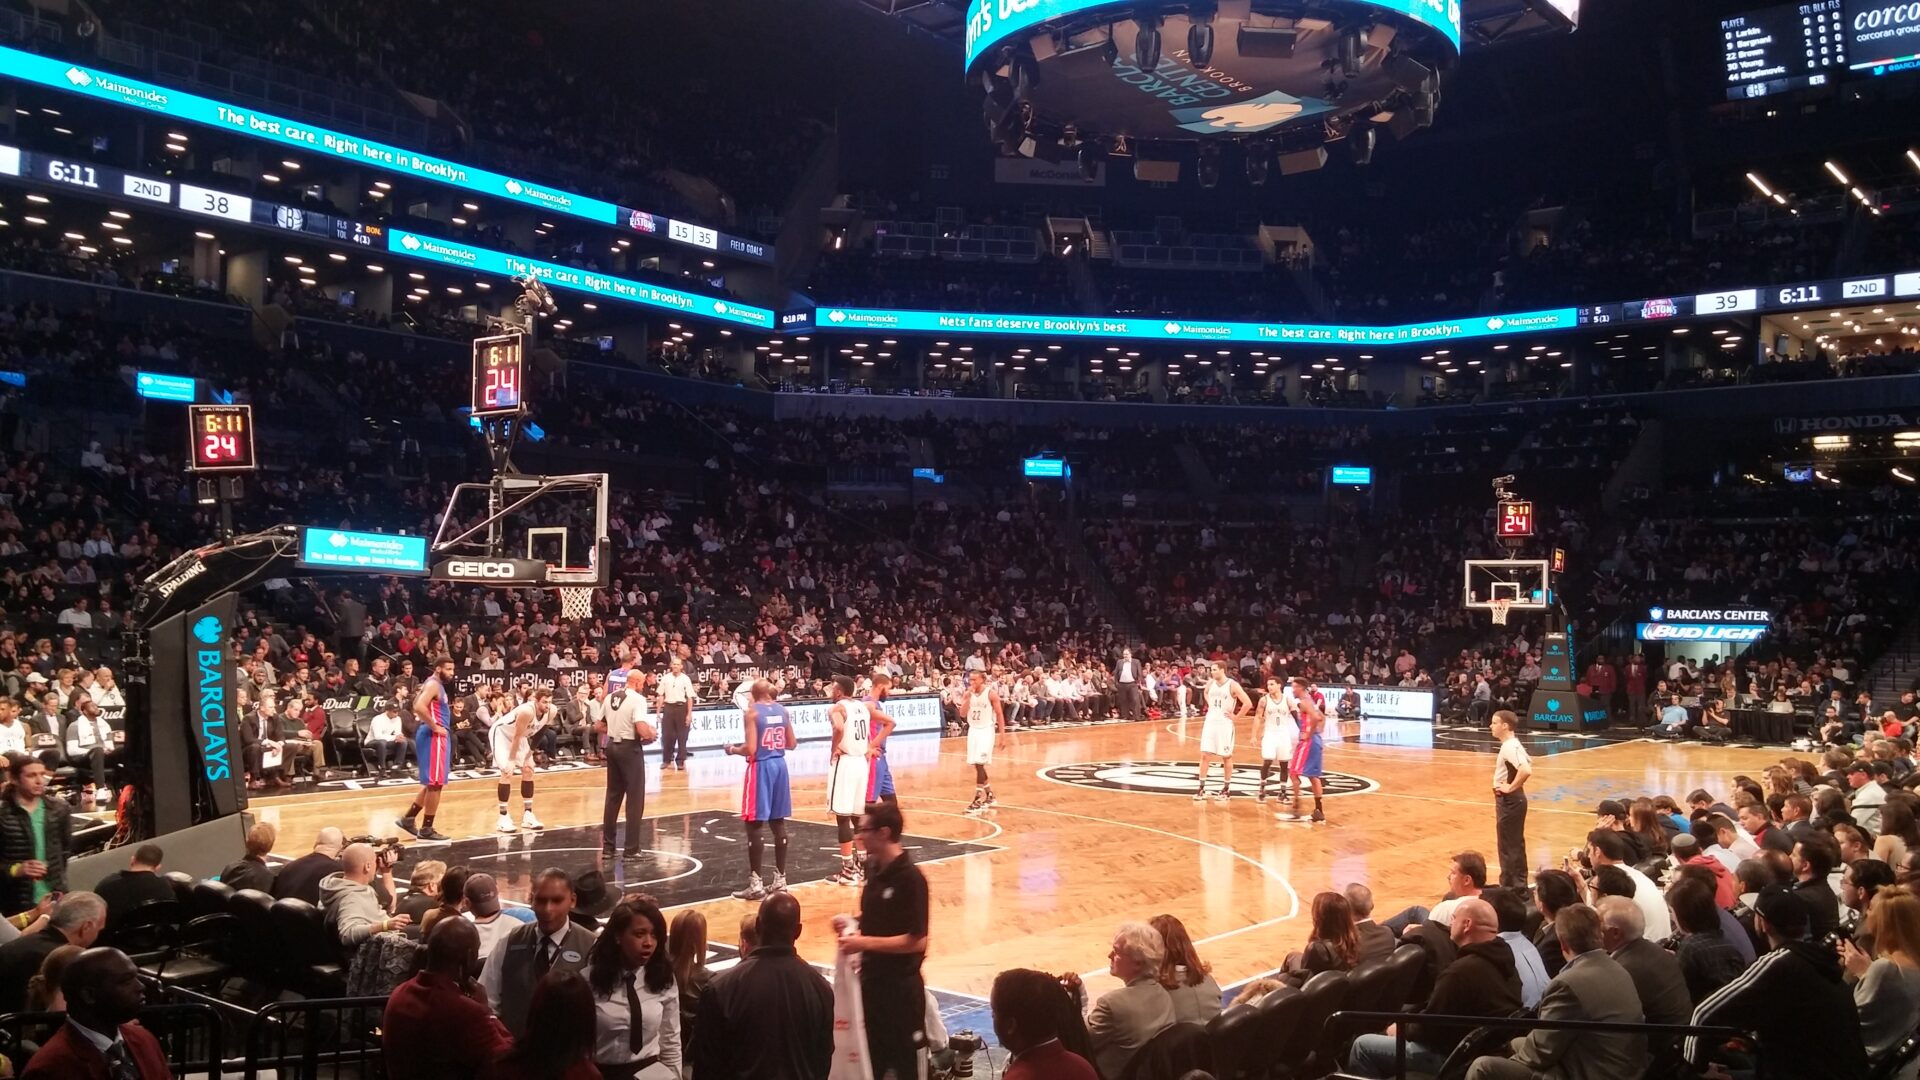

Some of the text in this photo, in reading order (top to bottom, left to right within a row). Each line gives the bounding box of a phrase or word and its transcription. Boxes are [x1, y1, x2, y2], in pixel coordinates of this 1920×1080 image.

[1799, 5, 1811, 16] STL
[1721, 17, 1745, 30] PLAYER
[1725, 12, 1840, 40] 0 Larkin 0 0 0
[1737, 35, 1772, 48] Bargnani
[1804, 28, 1811, 36] 0
[1819, 25, 1826, 33] 0
[1834, 23, 1841, 31] 0
[1856, 29, 1895, 42] corcoran
[1726, 33, 1842, 61] 22 Brown 1 0 0
[1727, 44, 1843, 71] 30 Young 0 0 2
[1728, 55, 1844, 81] 44 Bogdanovic 0 0 0
[95, 76, 168, 104] Maimonides
[217, 106, 470, 182] The best care. Right here in Brooklyn.
[49, 160, 98, 189] 6:11
[133, 181, 163, 198] 2ND
[203, 194, 230, 215] 38
[524, 186, 572, 207] Maimonides
[355, 222, 363, 233] 2
[675, 225, 712, 245] 15 35
[423, 241, 476, 264] Maimonides
[730, 239, 763, 257] FIELD GOALS
[505, 258, 695, 308] The best care. Right here in Brooklyn.
[1715, 282, 1877, 310] 39 6:11 2ND
[728, 306, 765, 323] Maimonides
[797, 313, 807, 322] PM
[848, 313, 898, 323] Maimonides
[1506, 315, 1559, 326] Maimonides
[1641, 305, 1679, 319] PISTONS
[939, 316, 1129, 333] Nets fans deserve Brooklyn's best.
[1183, 325, 1231, 334] Maimonides
[1258, 324, 1464, 342] The best care. Right here in Brooklyn.
[490, 345, 519, 367] 6:11
[486, 368, 515, 405] 24
[206, 415, 243, 433] 6:11
[1800, 412, 1909, 431] HONDA
[205, 434, 236, 459] 24
[1507, 505, 1529, 516] 6:11
[1504, 515, 1527, 533] 24
[447, 561, 515, 578] GEICO
[159, 561, 208, 599] SPALDING
[1666, 609, 1770, 621] BARCLAYS CENTER
[1656, 626, 1703, 639] BUD
[509, 672, 555, 691] jetBlue
[197, 650, 231, 782] BARCLAYS
[972, 710, 981, 720] 22
[1534, 713, 1574, 723] BARCLAYS
[762, 727, 786, 751] 43
[854, 719, 867, 741] 30
